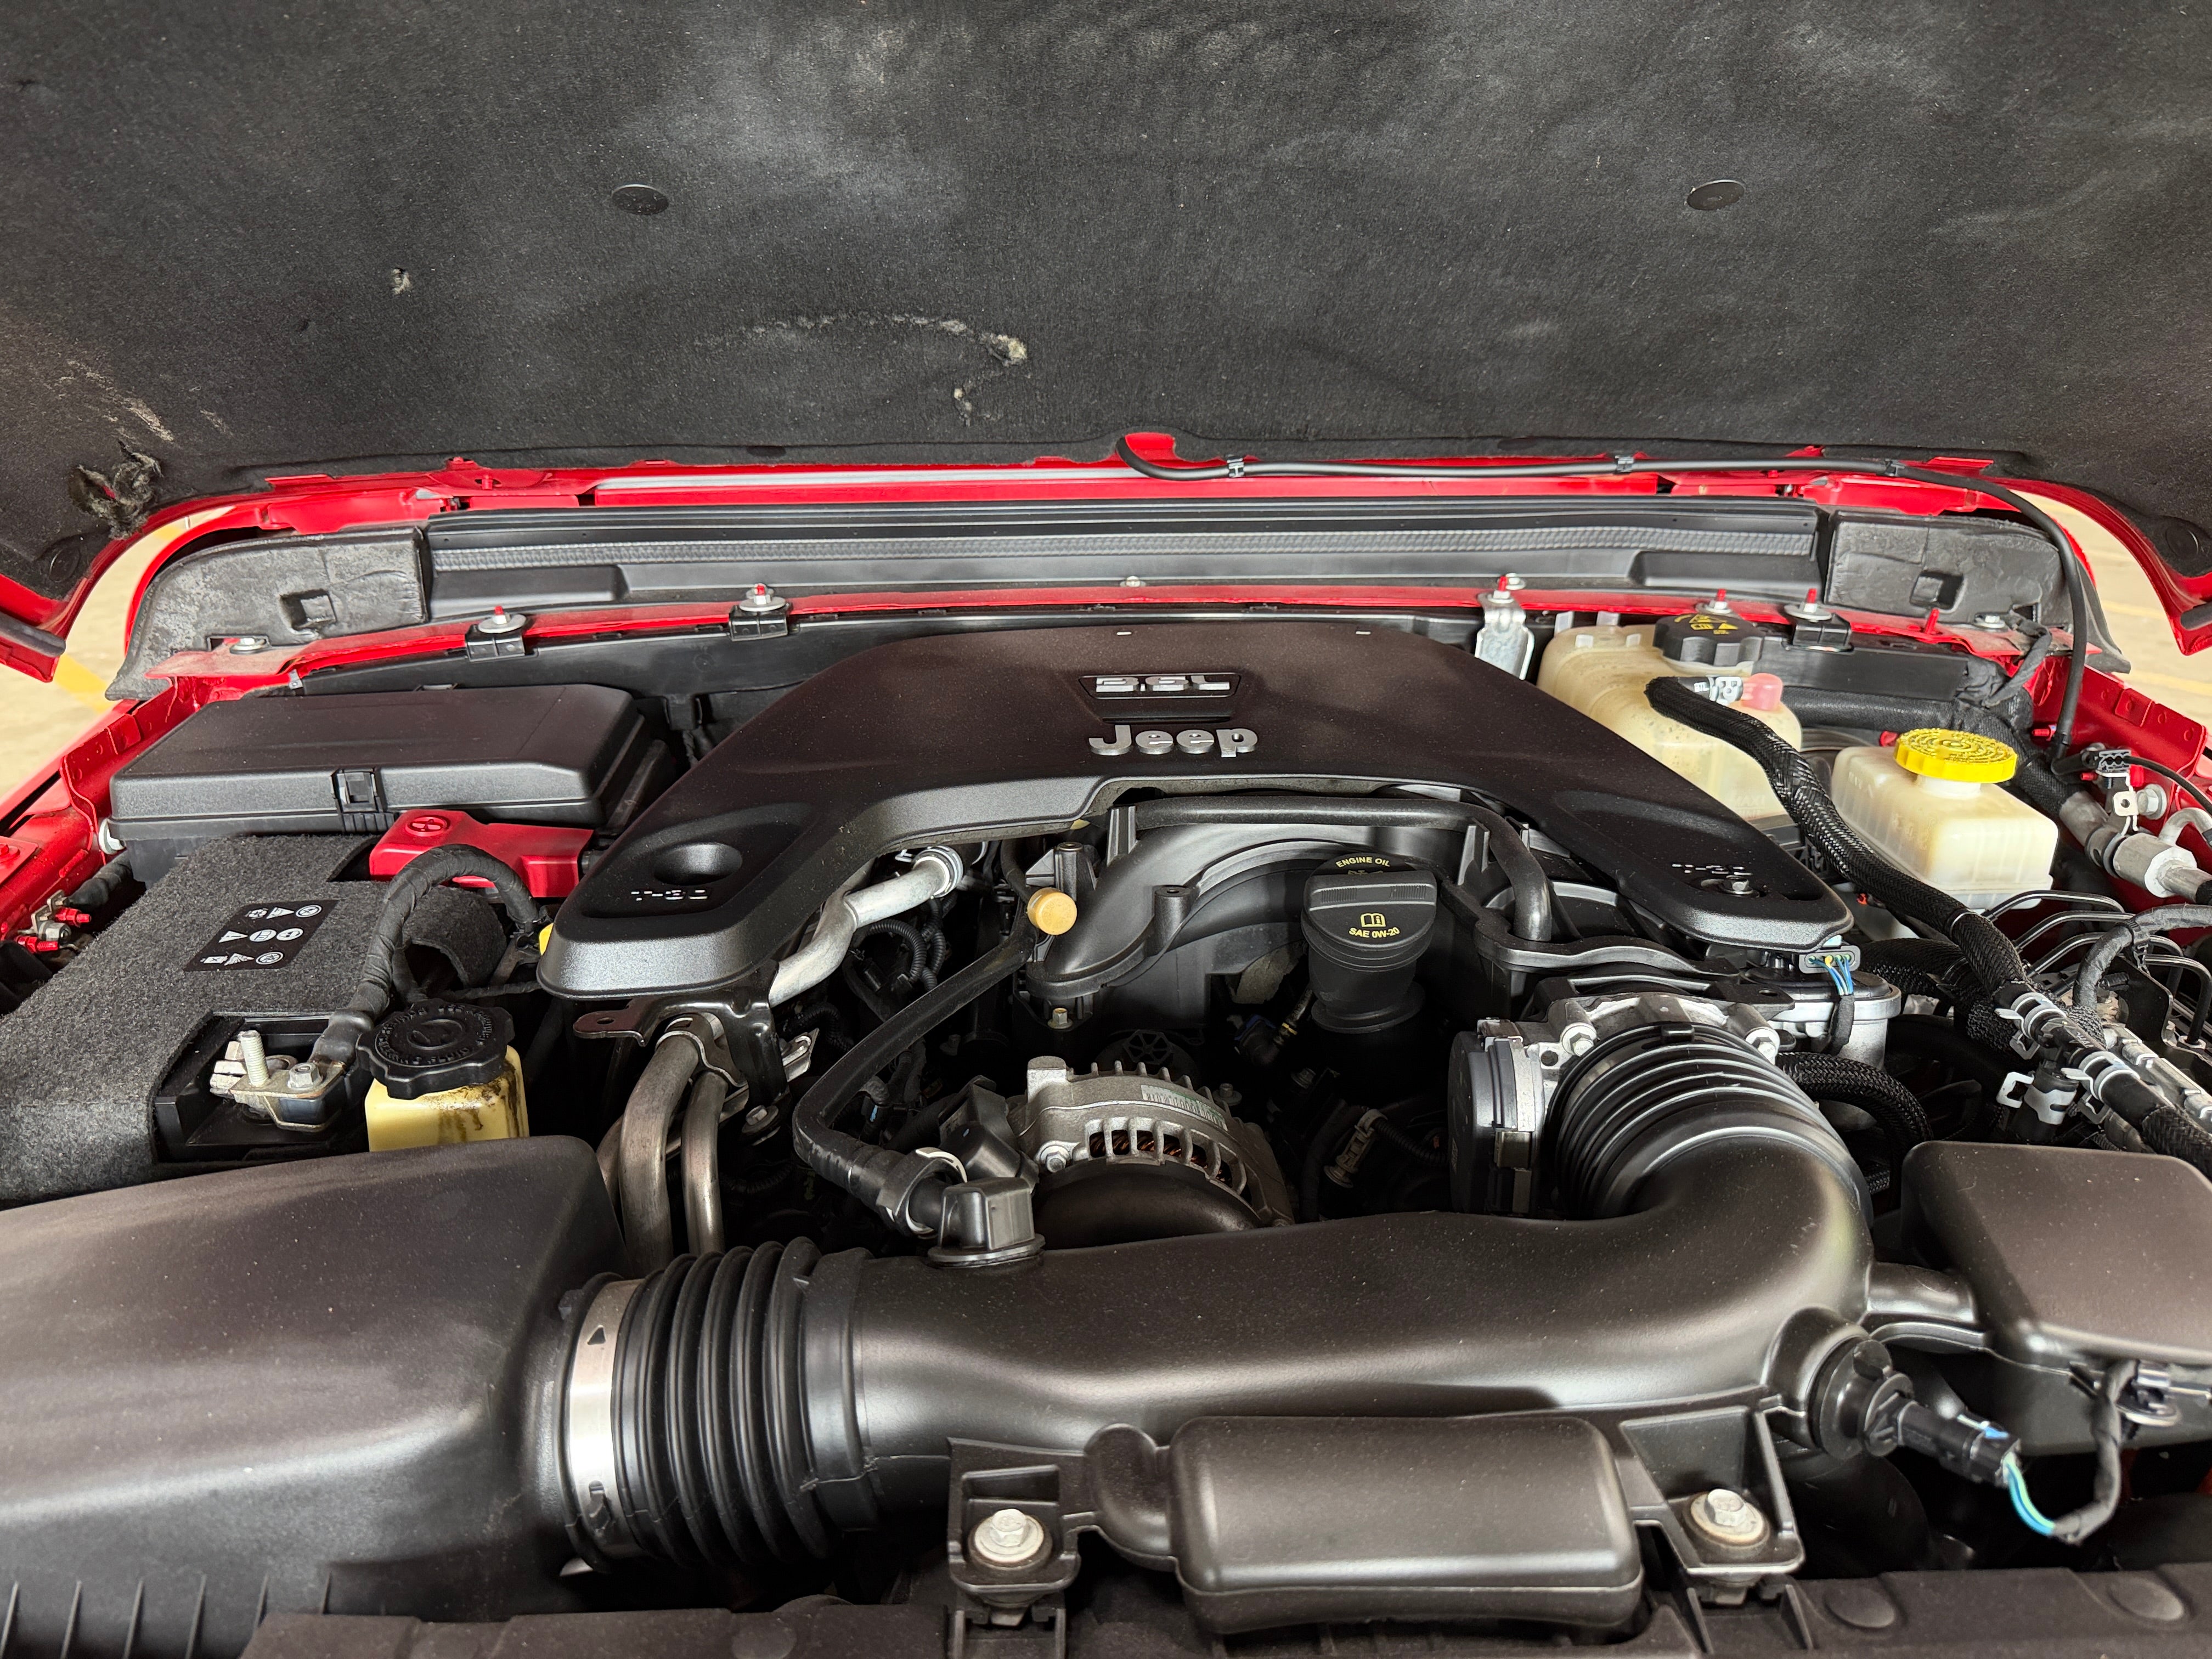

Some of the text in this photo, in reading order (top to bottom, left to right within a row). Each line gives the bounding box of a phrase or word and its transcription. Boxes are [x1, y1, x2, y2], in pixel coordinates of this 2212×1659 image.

[1096, 674, 1231, 692] 3.6L
[1088, 724, 1259, 758] Jeep
[1335, 856, 1391, 868] ENGINE OIL
[1348, 927, 1400, 938] SAE 0W-20
